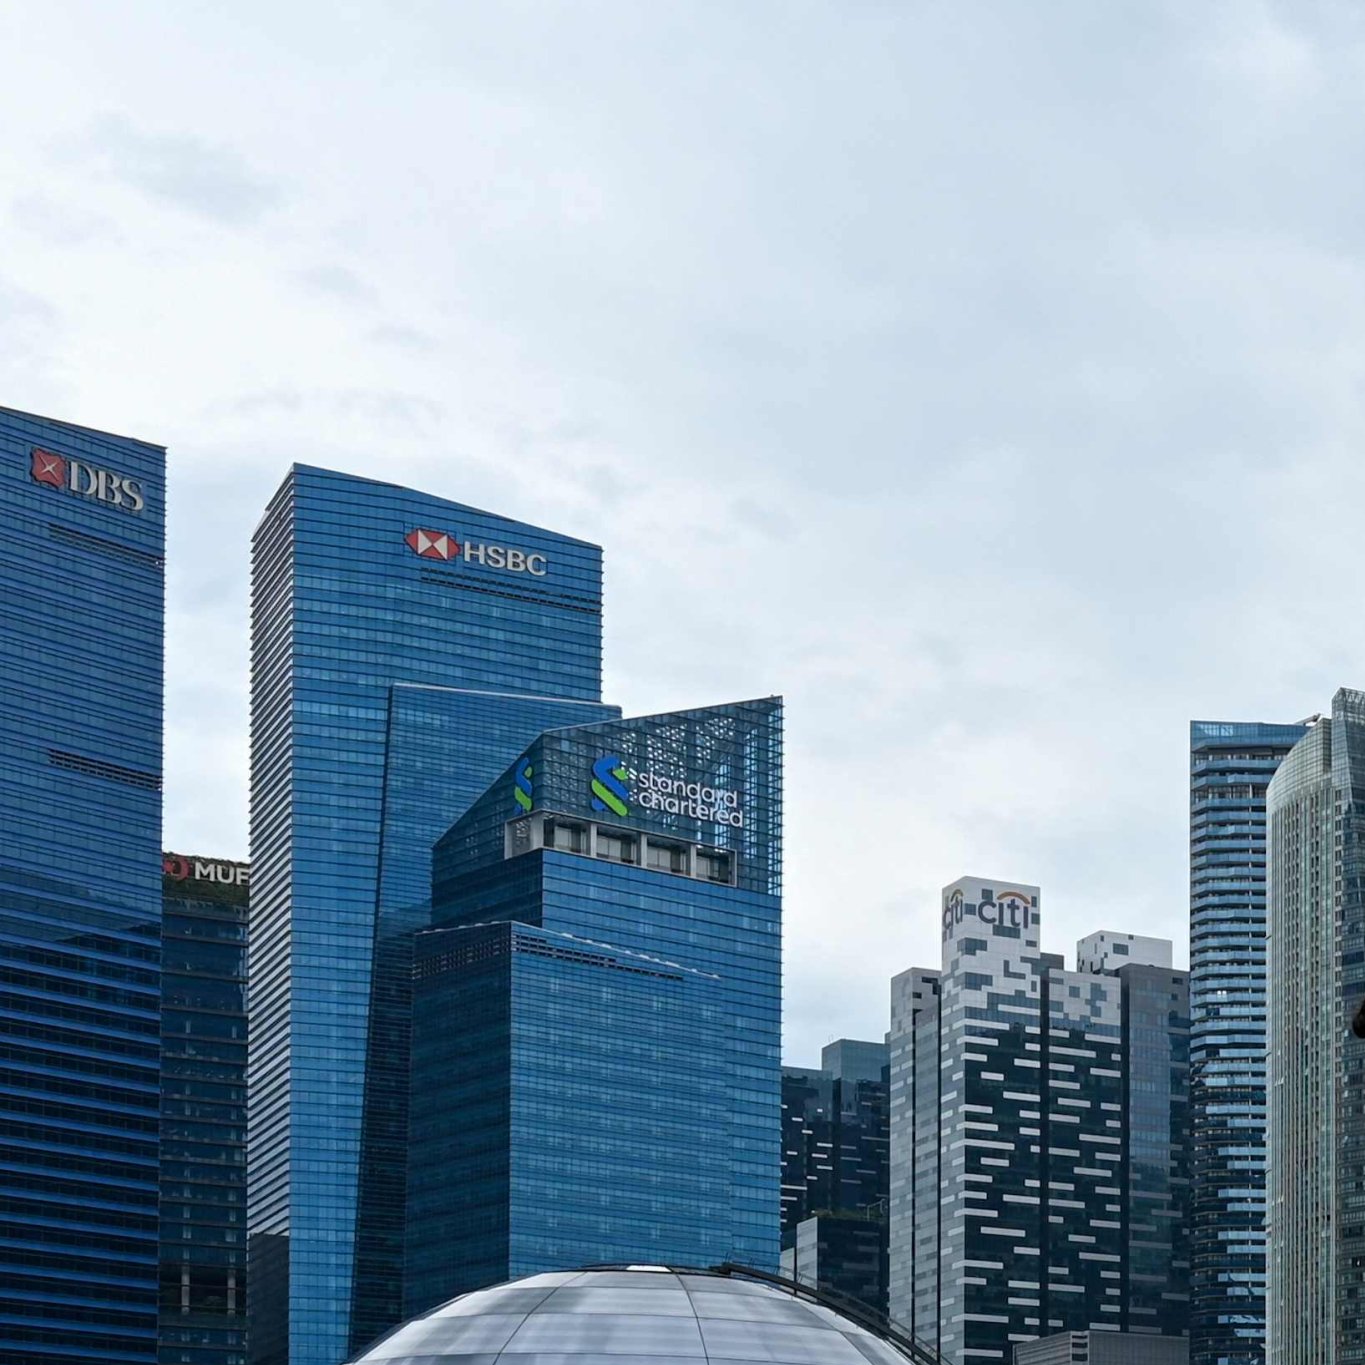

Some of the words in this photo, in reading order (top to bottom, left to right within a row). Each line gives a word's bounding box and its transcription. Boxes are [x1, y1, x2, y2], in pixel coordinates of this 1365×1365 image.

[69, 461, 144, 511] DBS
[463, 540, 547, 577] HSBC
[638, 770, 738, 808] standard
[638, 788, 743, 828] chartered
[943, 896, 963, 931] citi
[977, 897, 1029, 930] citi
